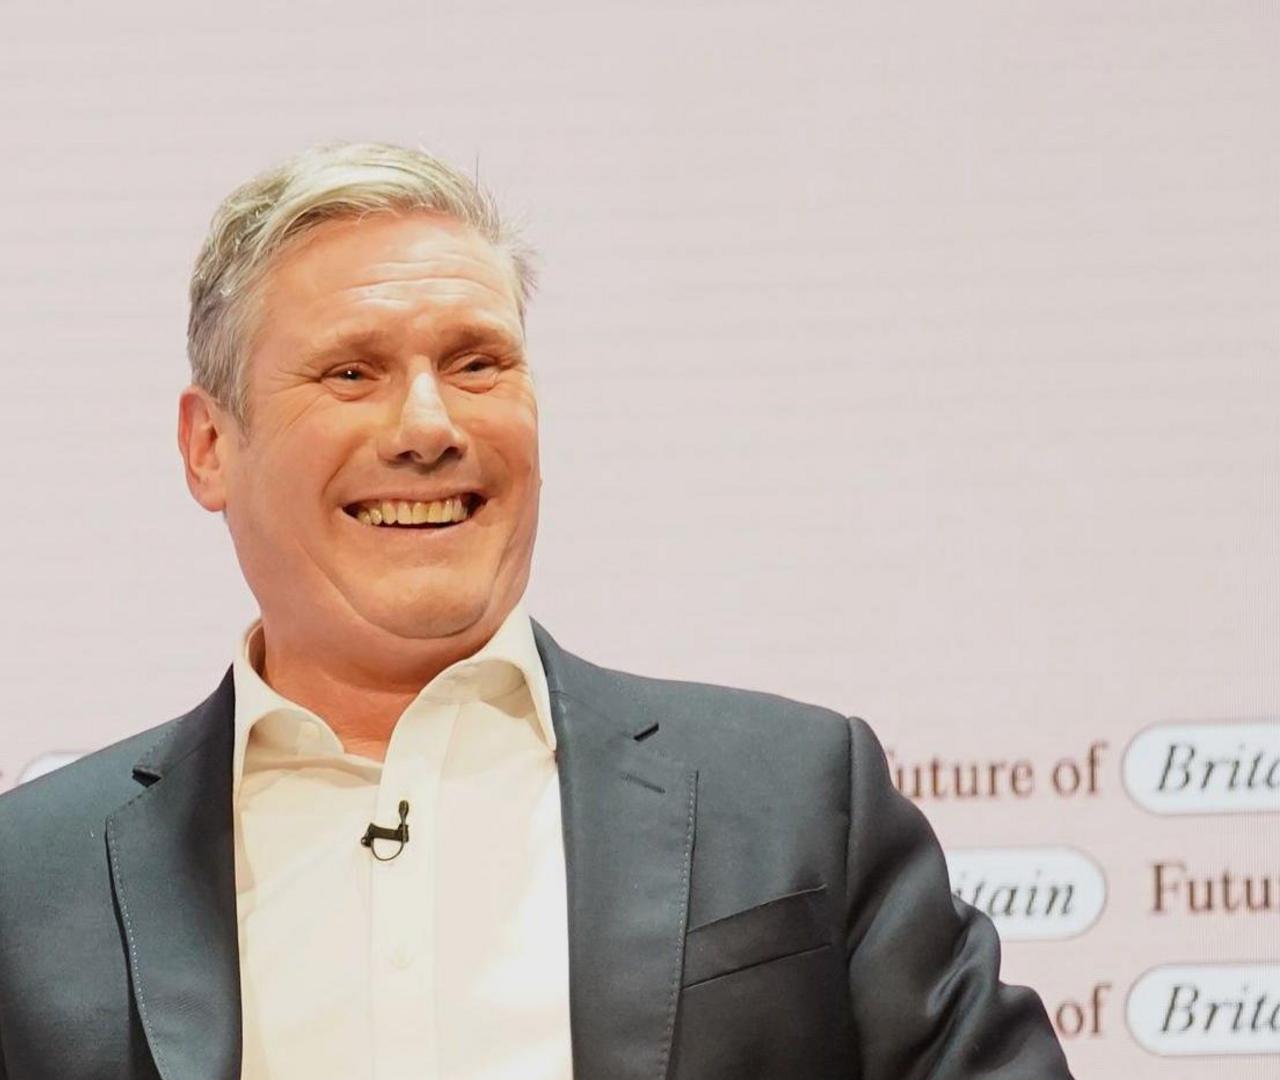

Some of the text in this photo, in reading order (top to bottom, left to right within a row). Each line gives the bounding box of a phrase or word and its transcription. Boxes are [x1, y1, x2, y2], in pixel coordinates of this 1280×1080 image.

[889, 740, 1280, 799] uture of Brit
[1150, 861, 1275, 916] Futu
[1054, 983, 1280, 1037] of Brit
